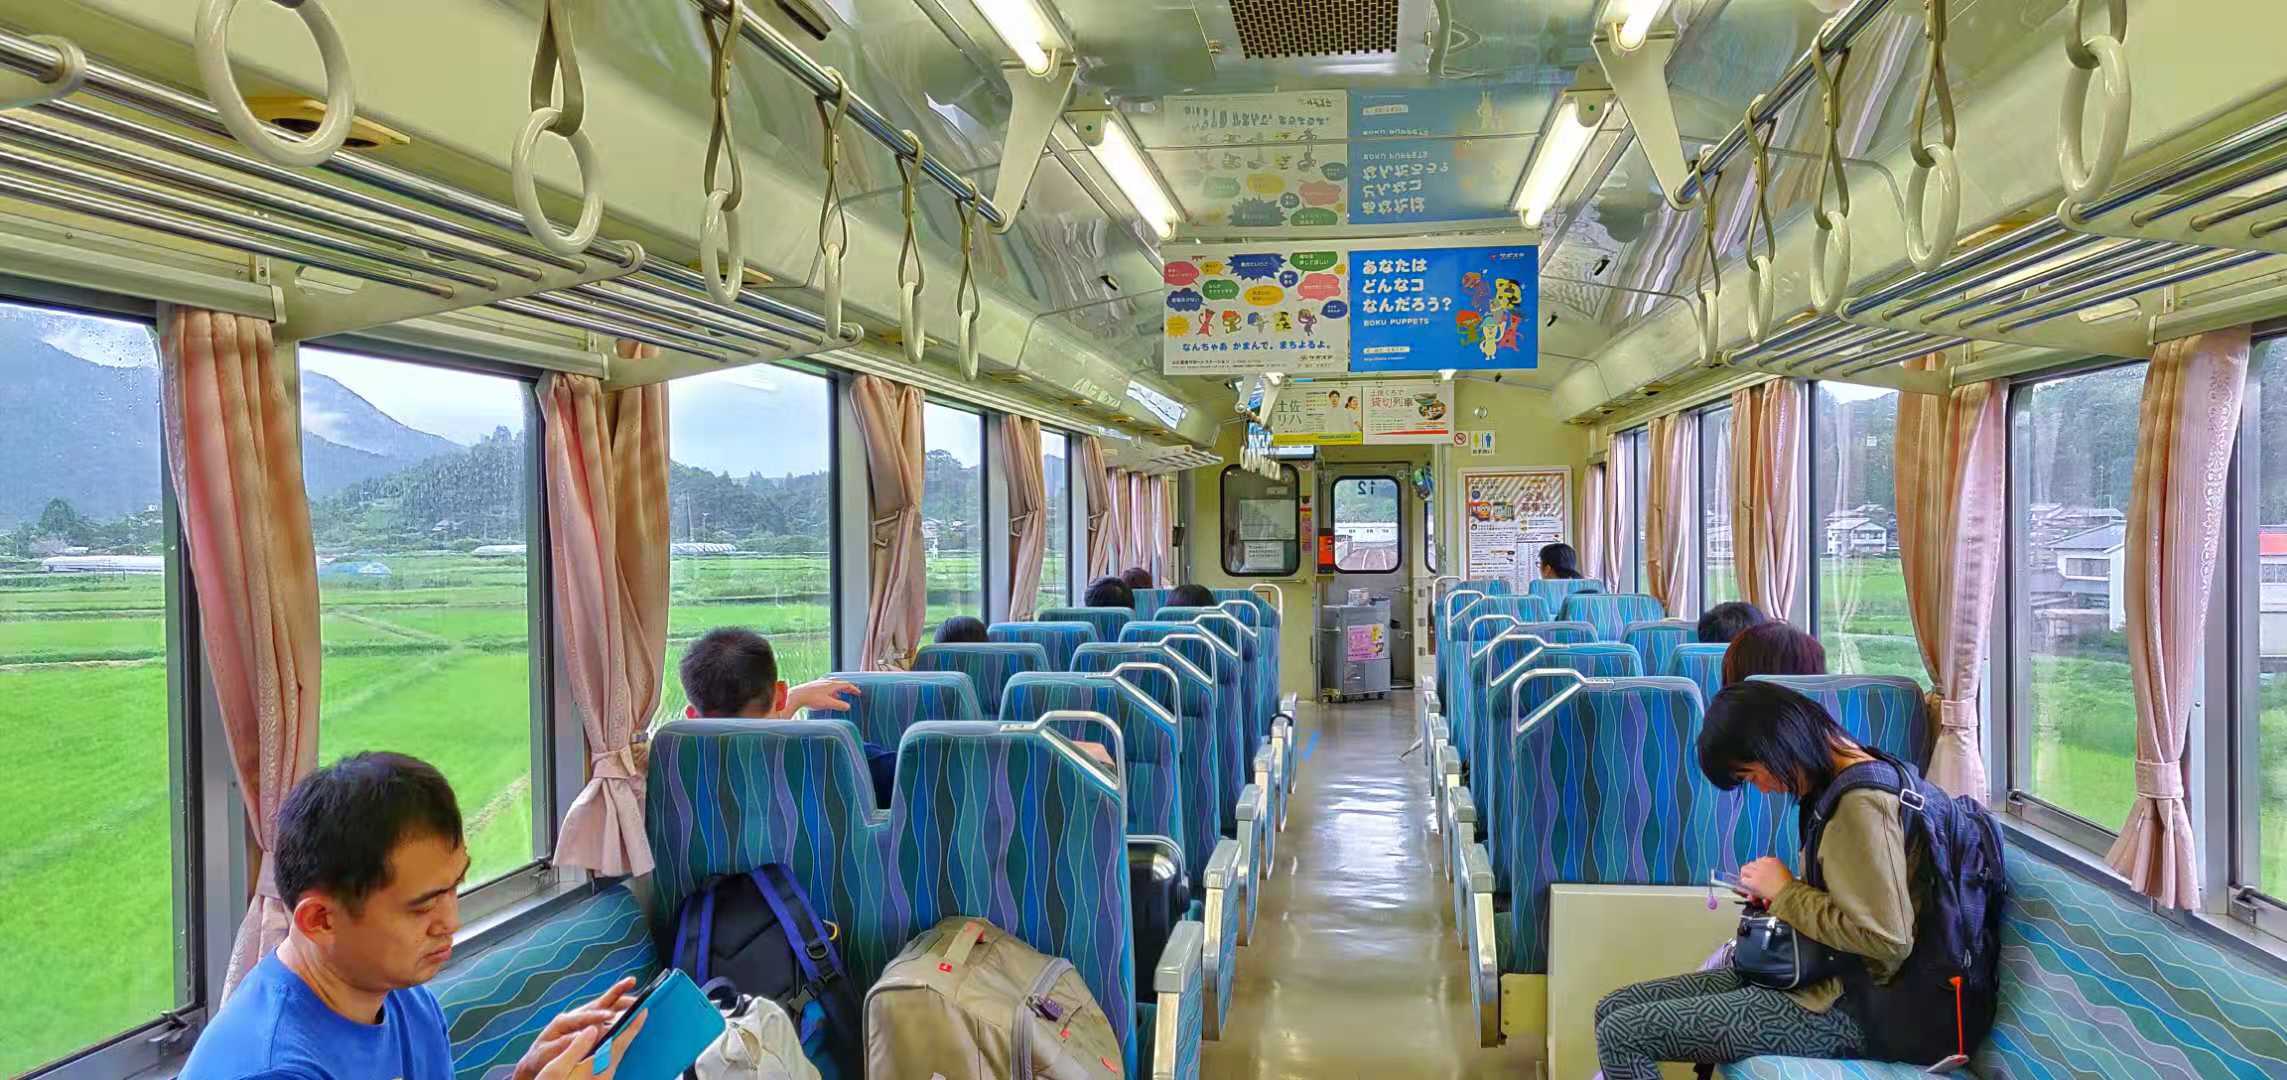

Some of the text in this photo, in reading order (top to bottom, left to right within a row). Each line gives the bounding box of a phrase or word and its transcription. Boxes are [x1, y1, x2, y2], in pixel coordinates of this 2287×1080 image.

[1362, 258, 1427, 275] あなたは
[1362, 277, 1424, 294] どんなコ
[1362, 296, 1453, 313] なんだろう?
[1363, 318, 1430, 327] BOKU PUPPETS
[1182, 343, 1228, 352] なんちゃあ
[1279, 339, 1331, 350] まちよるよ。
[1278, 399, 1302, 413] 土佐
[1370, 398, 1414, 409] 貸切列車
